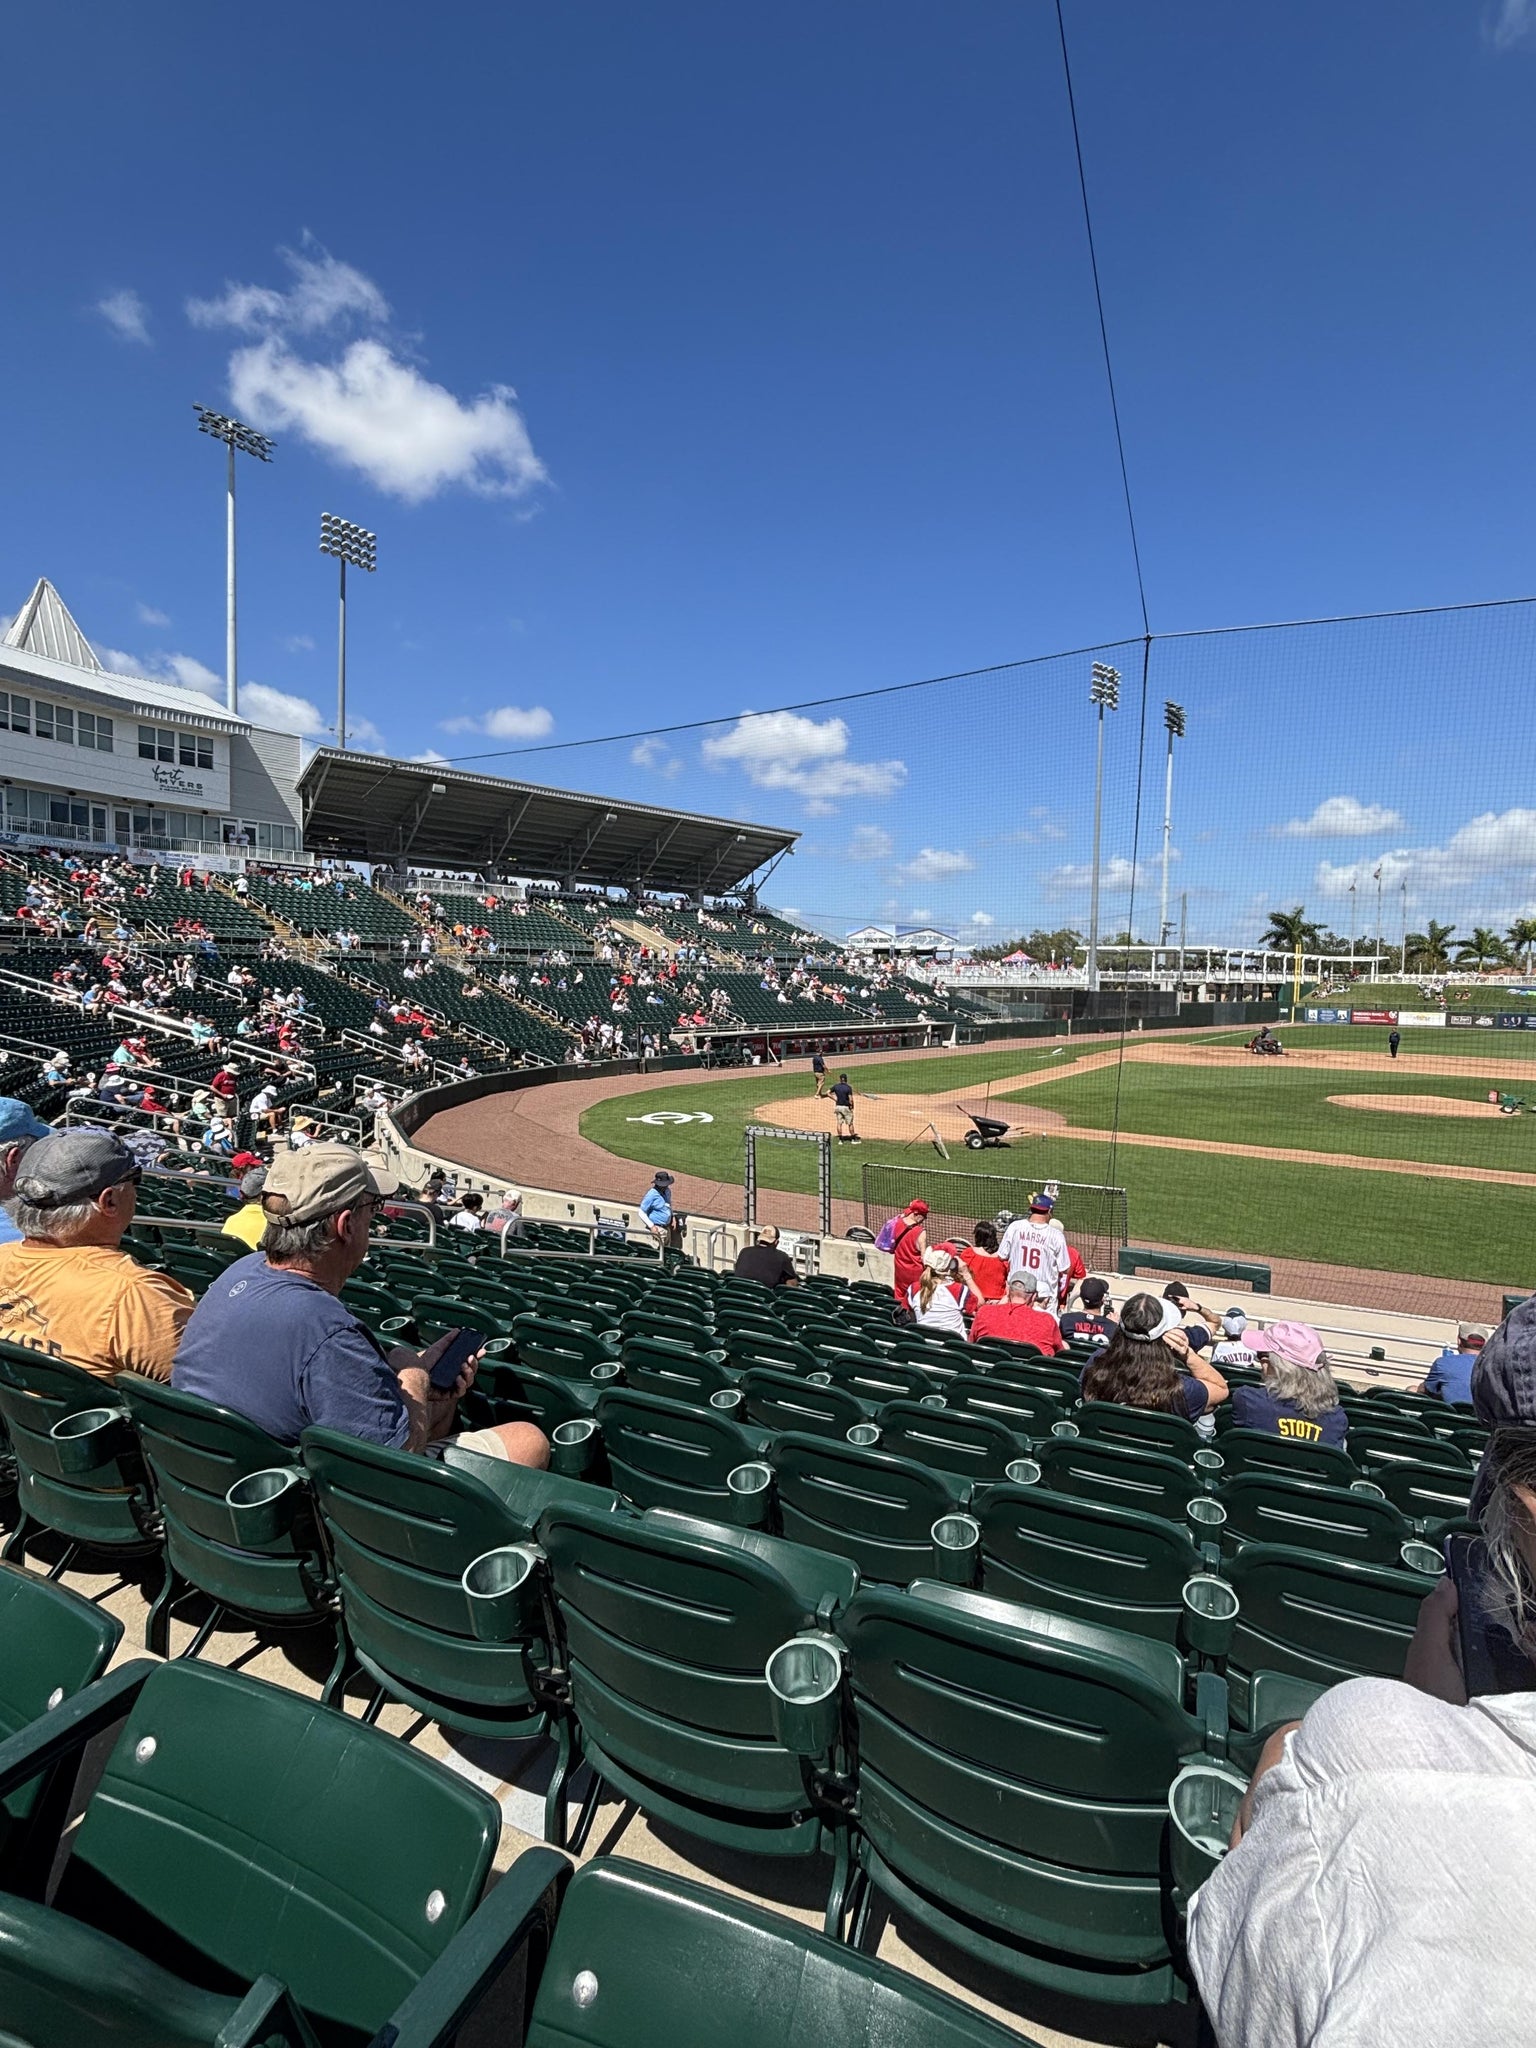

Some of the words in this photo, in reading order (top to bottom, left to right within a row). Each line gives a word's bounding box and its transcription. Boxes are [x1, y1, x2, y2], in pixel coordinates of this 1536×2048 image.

[152, 765, 184, 781] fort
[159, 778, 204, 790] MYERS
[1020, 1231, 1047, 1245] MARSH
[1021, 1245, 1041, 1269] 16
[1075, 1322, 1105, 1333] DURAN
[1223, 1352, 1252, 1363] BUXTON
[1278, 1418, 1323, 1442] STOTT
